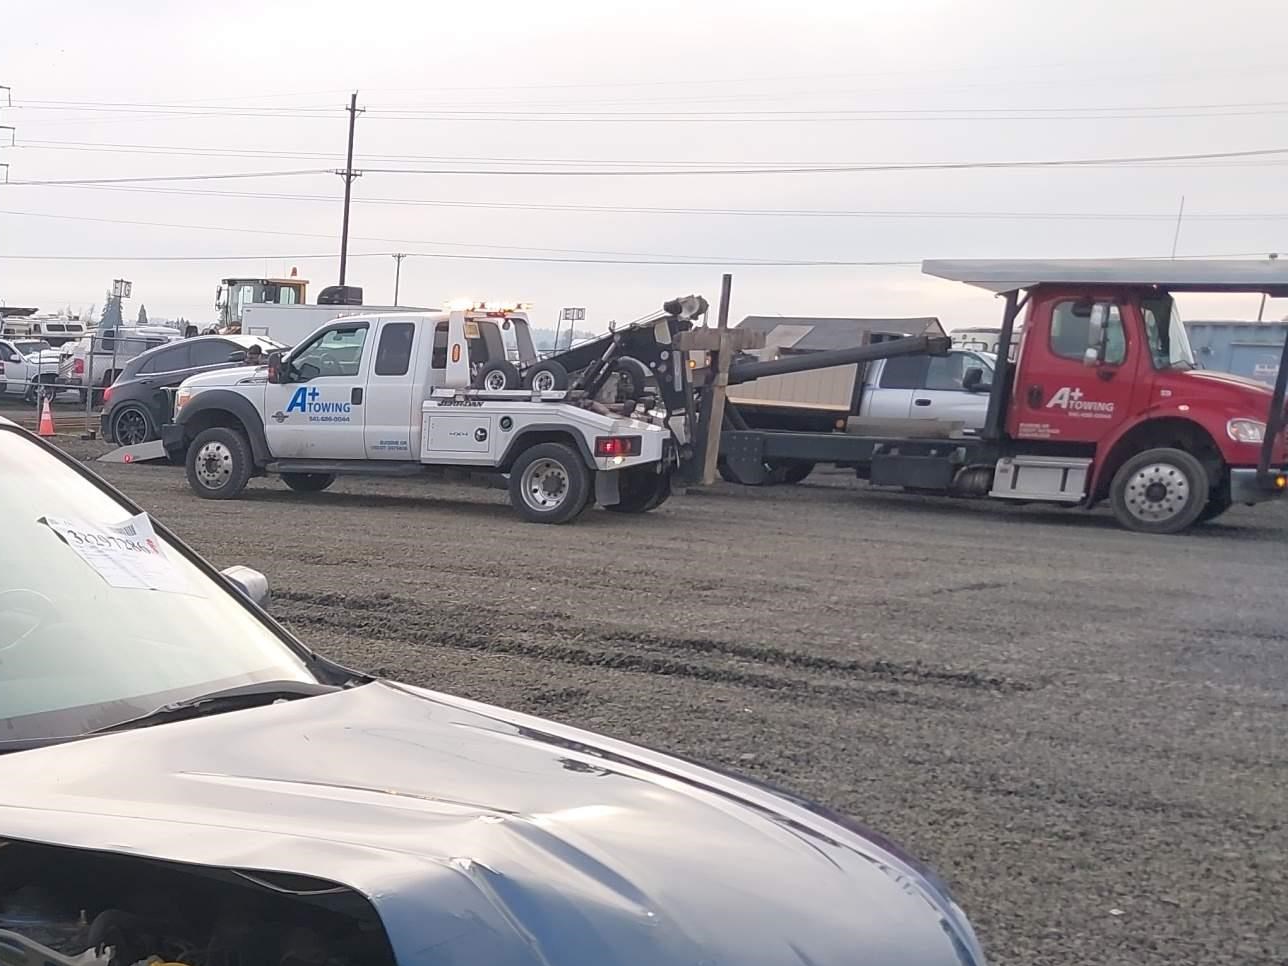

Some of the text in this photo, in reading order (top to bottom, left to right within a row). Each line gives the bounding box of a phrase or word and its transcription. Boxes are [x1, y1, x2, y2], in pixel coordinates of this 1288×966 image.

[287, 386, 351, 413] A+ TOWING
[1046, 387, 1114, 412] A+ TOWING
